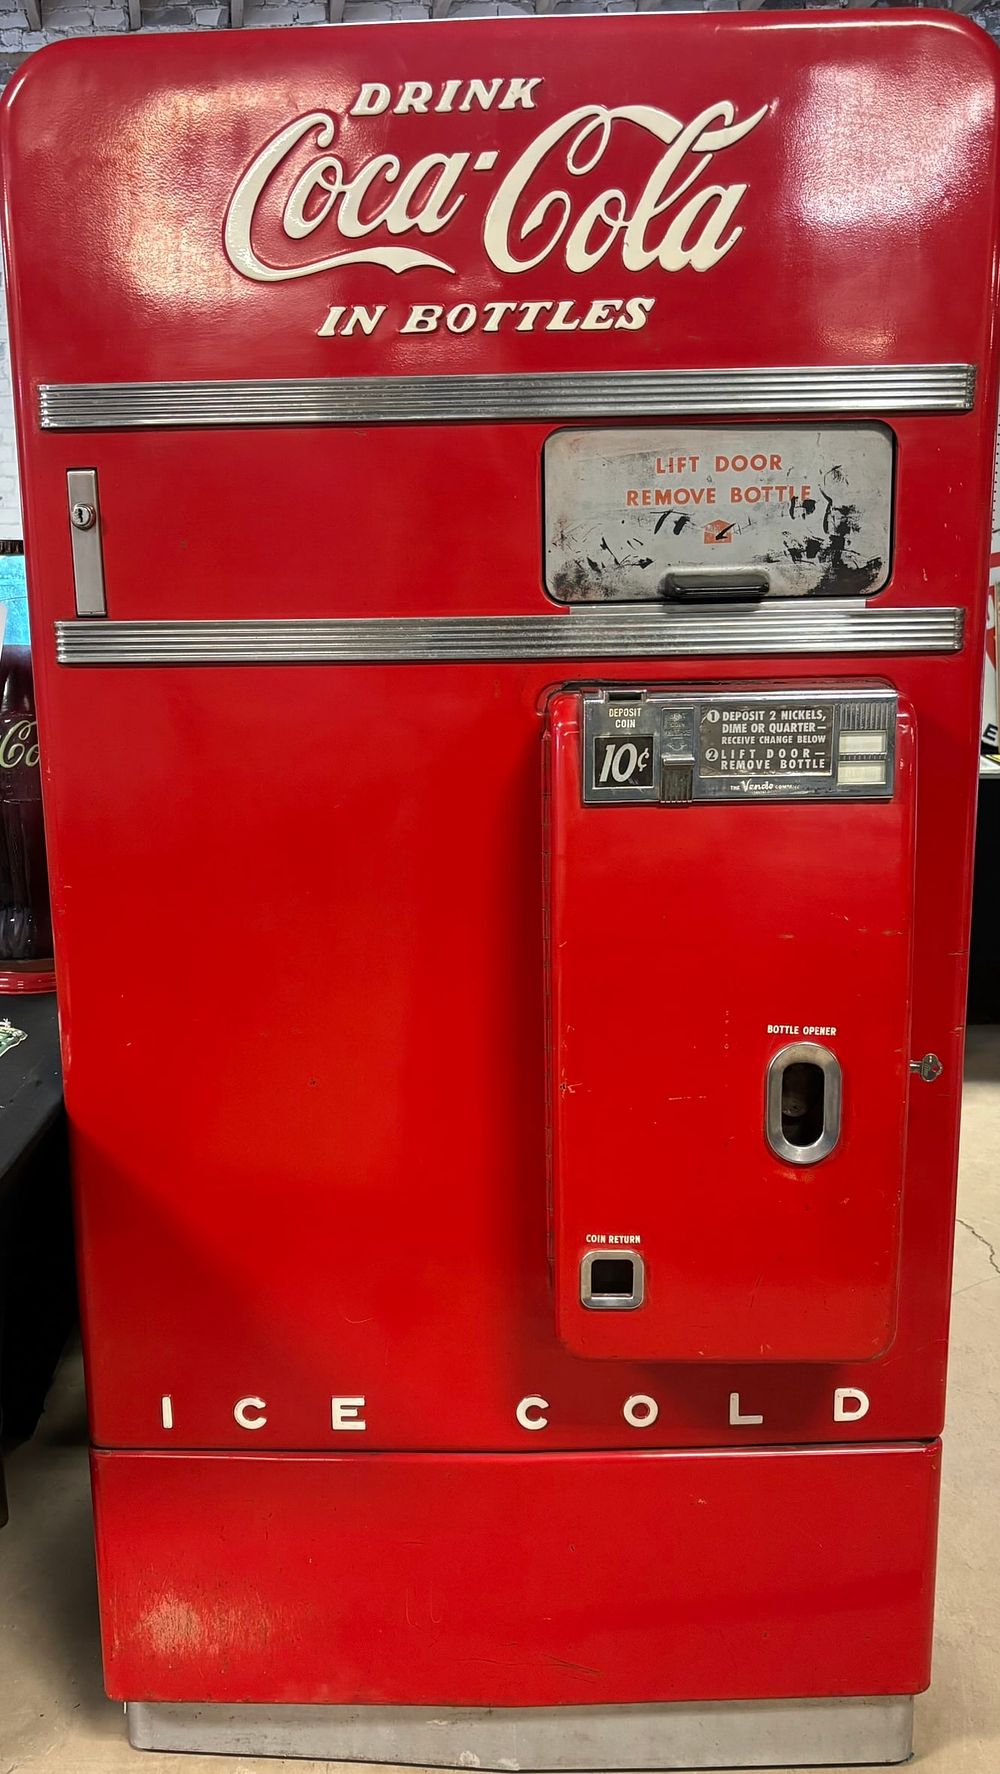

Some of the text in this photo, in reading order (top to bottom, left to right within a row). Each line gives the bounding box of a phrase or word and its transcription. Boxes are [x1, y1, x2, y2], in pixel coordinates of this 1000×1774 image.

[350, 78, 543, 116] DRINK
[223, 100, 769, 282] Coca-Cola
[317, 297, 655, 337] IN BOTTLES
[656, 454, 782, 474] LIFT DOOR
[626, 485, 811, 507] REMOVE BOTTLE
[608, 707, 642, 718] DEPOSIT
[722, 711, 765, 721] DEPOSIT
[769, 710, 777, 720] 2
[781, 709, 827, 721] NICKELS,
[615, 719, 636, 728] COIN
[722, 722, 748, 734] DIME
[751, 722, 766, 733] OR
[721, 734, 827, 745] RECEIVE CHANGE BELOW
[721, 749, 756, 760] LIFT
[599, 742, 650, 783] 10¢
[721, 758, 826, 770] REMOVE BOTTLE
[767, 1024, 837, 1036] BOTTLE OPENER
[586, 1234, 641, 1244] COIN RETURN
[161, 1388, 870, 1431] ICE COLD
